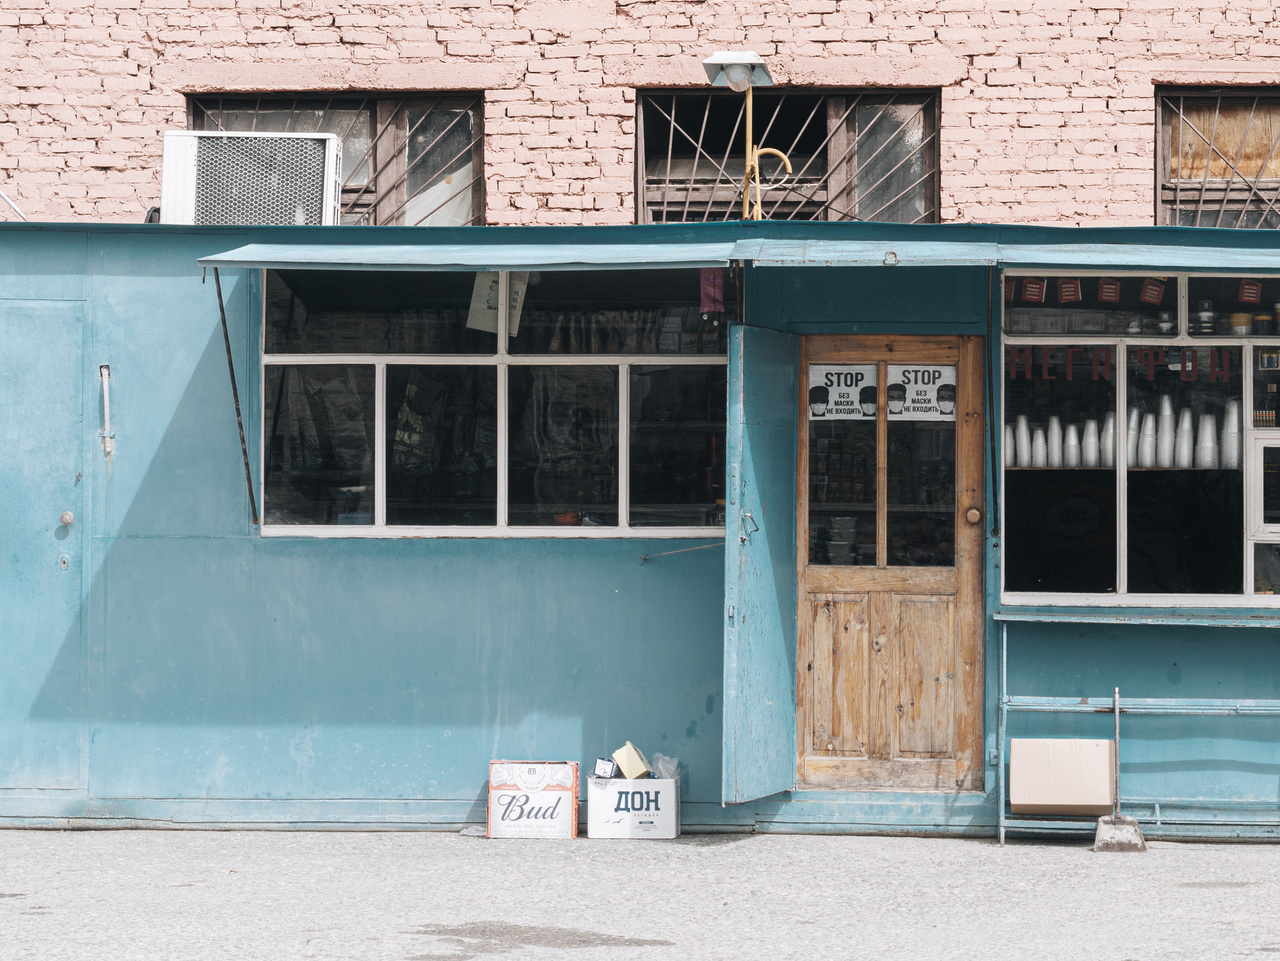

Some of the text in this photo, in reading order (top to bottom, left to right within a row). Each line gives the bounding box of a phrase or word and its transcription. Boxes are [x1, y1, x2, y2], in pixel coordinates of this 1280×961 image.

[824, 372, 865, 388] STOP
[901, 369, 942, 385] STOP
[497, 793, 562, 822] Bud
[614, 790, 660, 812] ДОН
